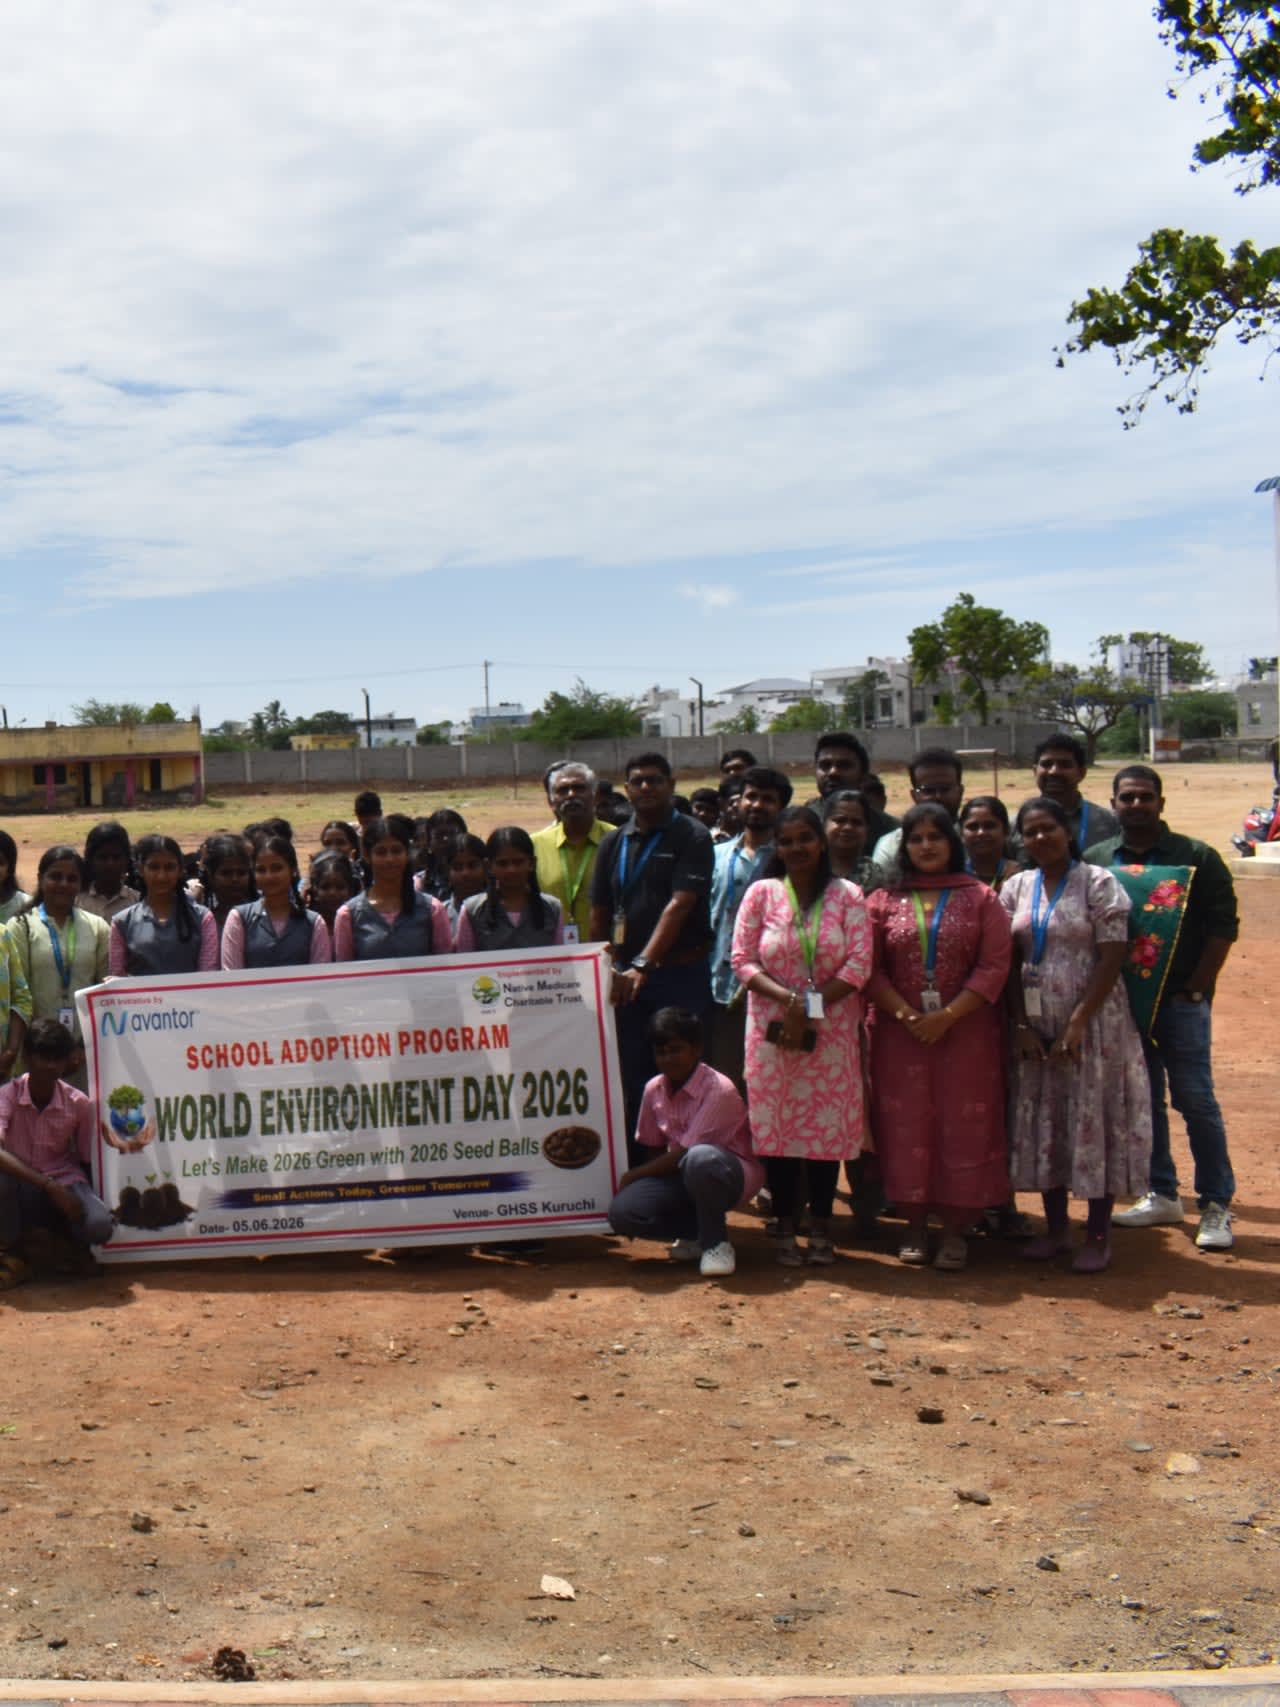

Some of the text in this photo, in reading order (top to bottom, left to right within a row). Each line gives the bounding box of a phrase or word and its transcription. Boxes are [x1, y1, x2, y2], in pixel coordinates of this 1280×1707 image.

[503, 980, 581, 993] Native Medicare
[504, 993, 582, 1007] Charitable Trust
[131, 1008, 195, 1031] avantor
[187, 1024, 509, 1070] SCHOOL ADOPTION PROGRAM
[155, 1068, 589, 1142] WORLD ENVIRONMENT DAY 2026
[182, 1136, 539, 1177] Let's Make 2026 Green with 2026 Seed Balls
[254, 1191, 285, 1202] Small
[290, 1189, 334, 1200] Actions
[379, 1183, 426, 1195] Greener
[430, 1179, 490, 1191] Tomorrow
[497, 1202, 538, 1217] GHSS
[541, 1198, 595, 1213] Kuruchi
[232, 1217, 305, 1232] 05.06.2026
